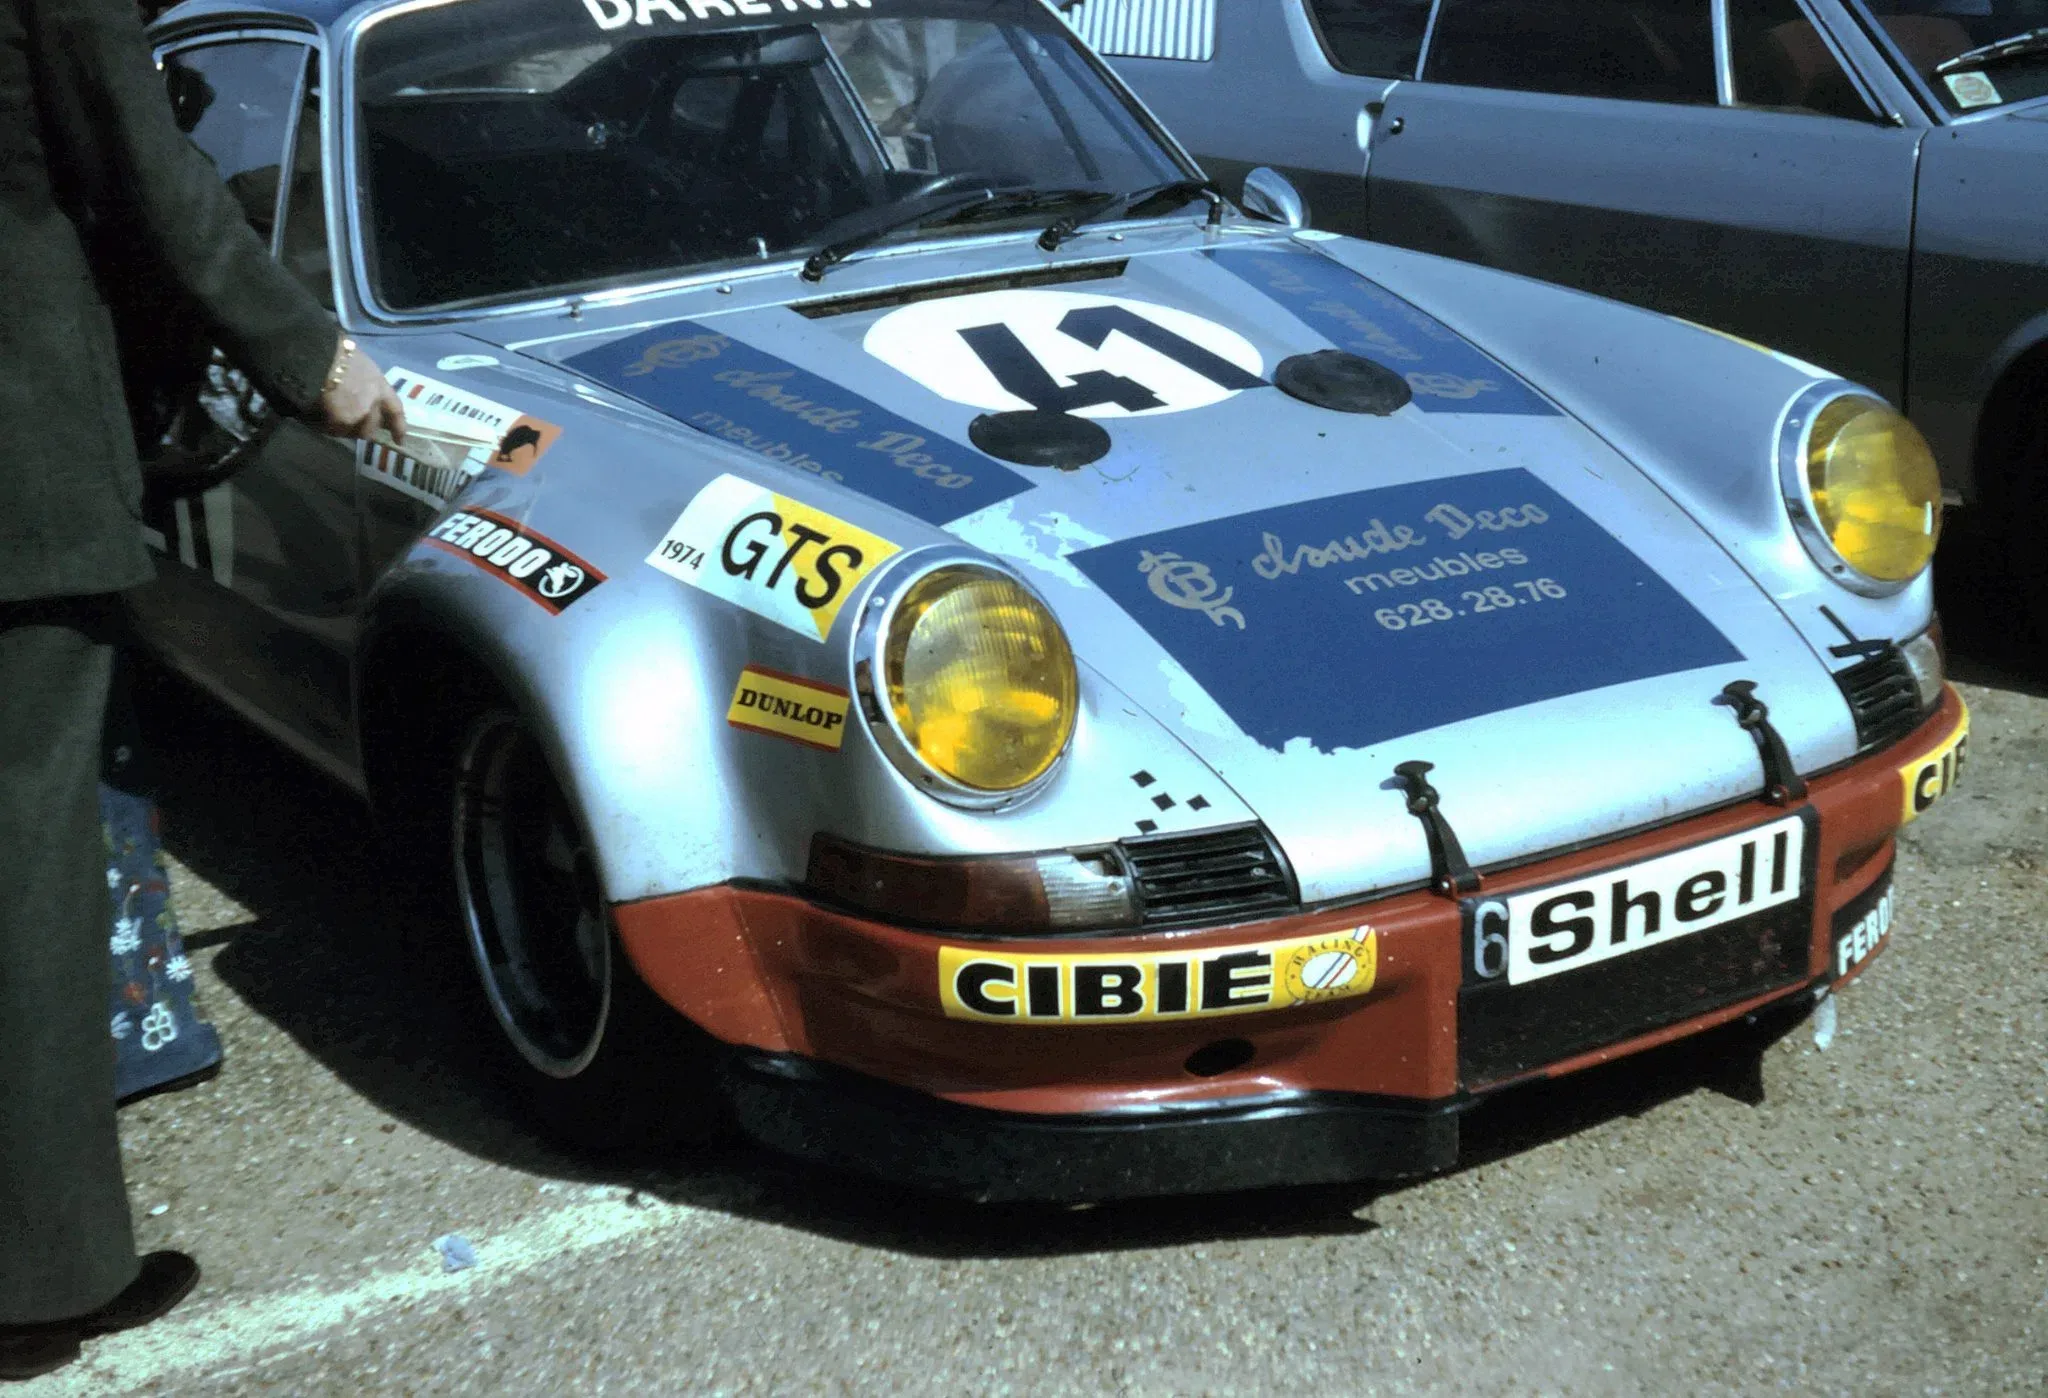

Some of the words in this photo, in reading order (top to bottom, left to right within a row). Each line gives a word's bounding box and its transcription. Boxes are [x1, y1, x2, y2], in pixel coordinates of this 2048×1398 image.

[429, 512, 552, 578] FERODO
[1426, 502, 1549, 541] Deco
[660, 539, 705, 570] 1974
[721, 511, 863, 609] GTS
[1343, 547, 1529, 596] meubles
[737, 688, 842, 730] DUNLOP
[1528, 830, 1787, 964] Shell
[954, 950, 1273, 1017] CIBIE
